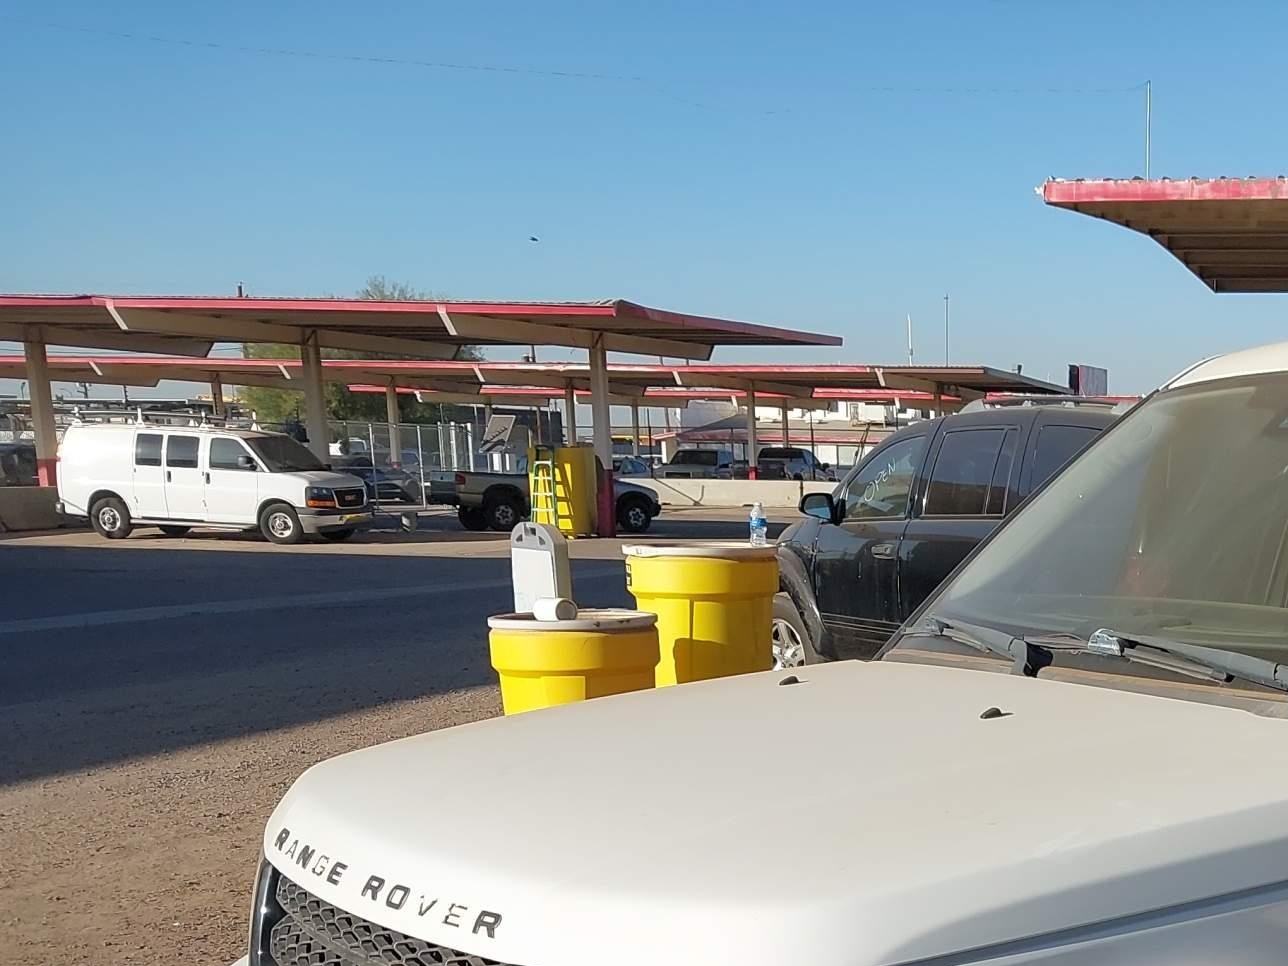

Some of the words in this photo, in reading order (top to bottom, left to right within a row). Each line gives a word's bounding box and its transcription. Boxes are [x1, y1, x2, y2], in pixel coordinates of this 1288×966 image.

[863, 457, 896, 502] OPEN
[274, 827, 349, 886] RANGE
[361, 874, 503, 939] ROVER
